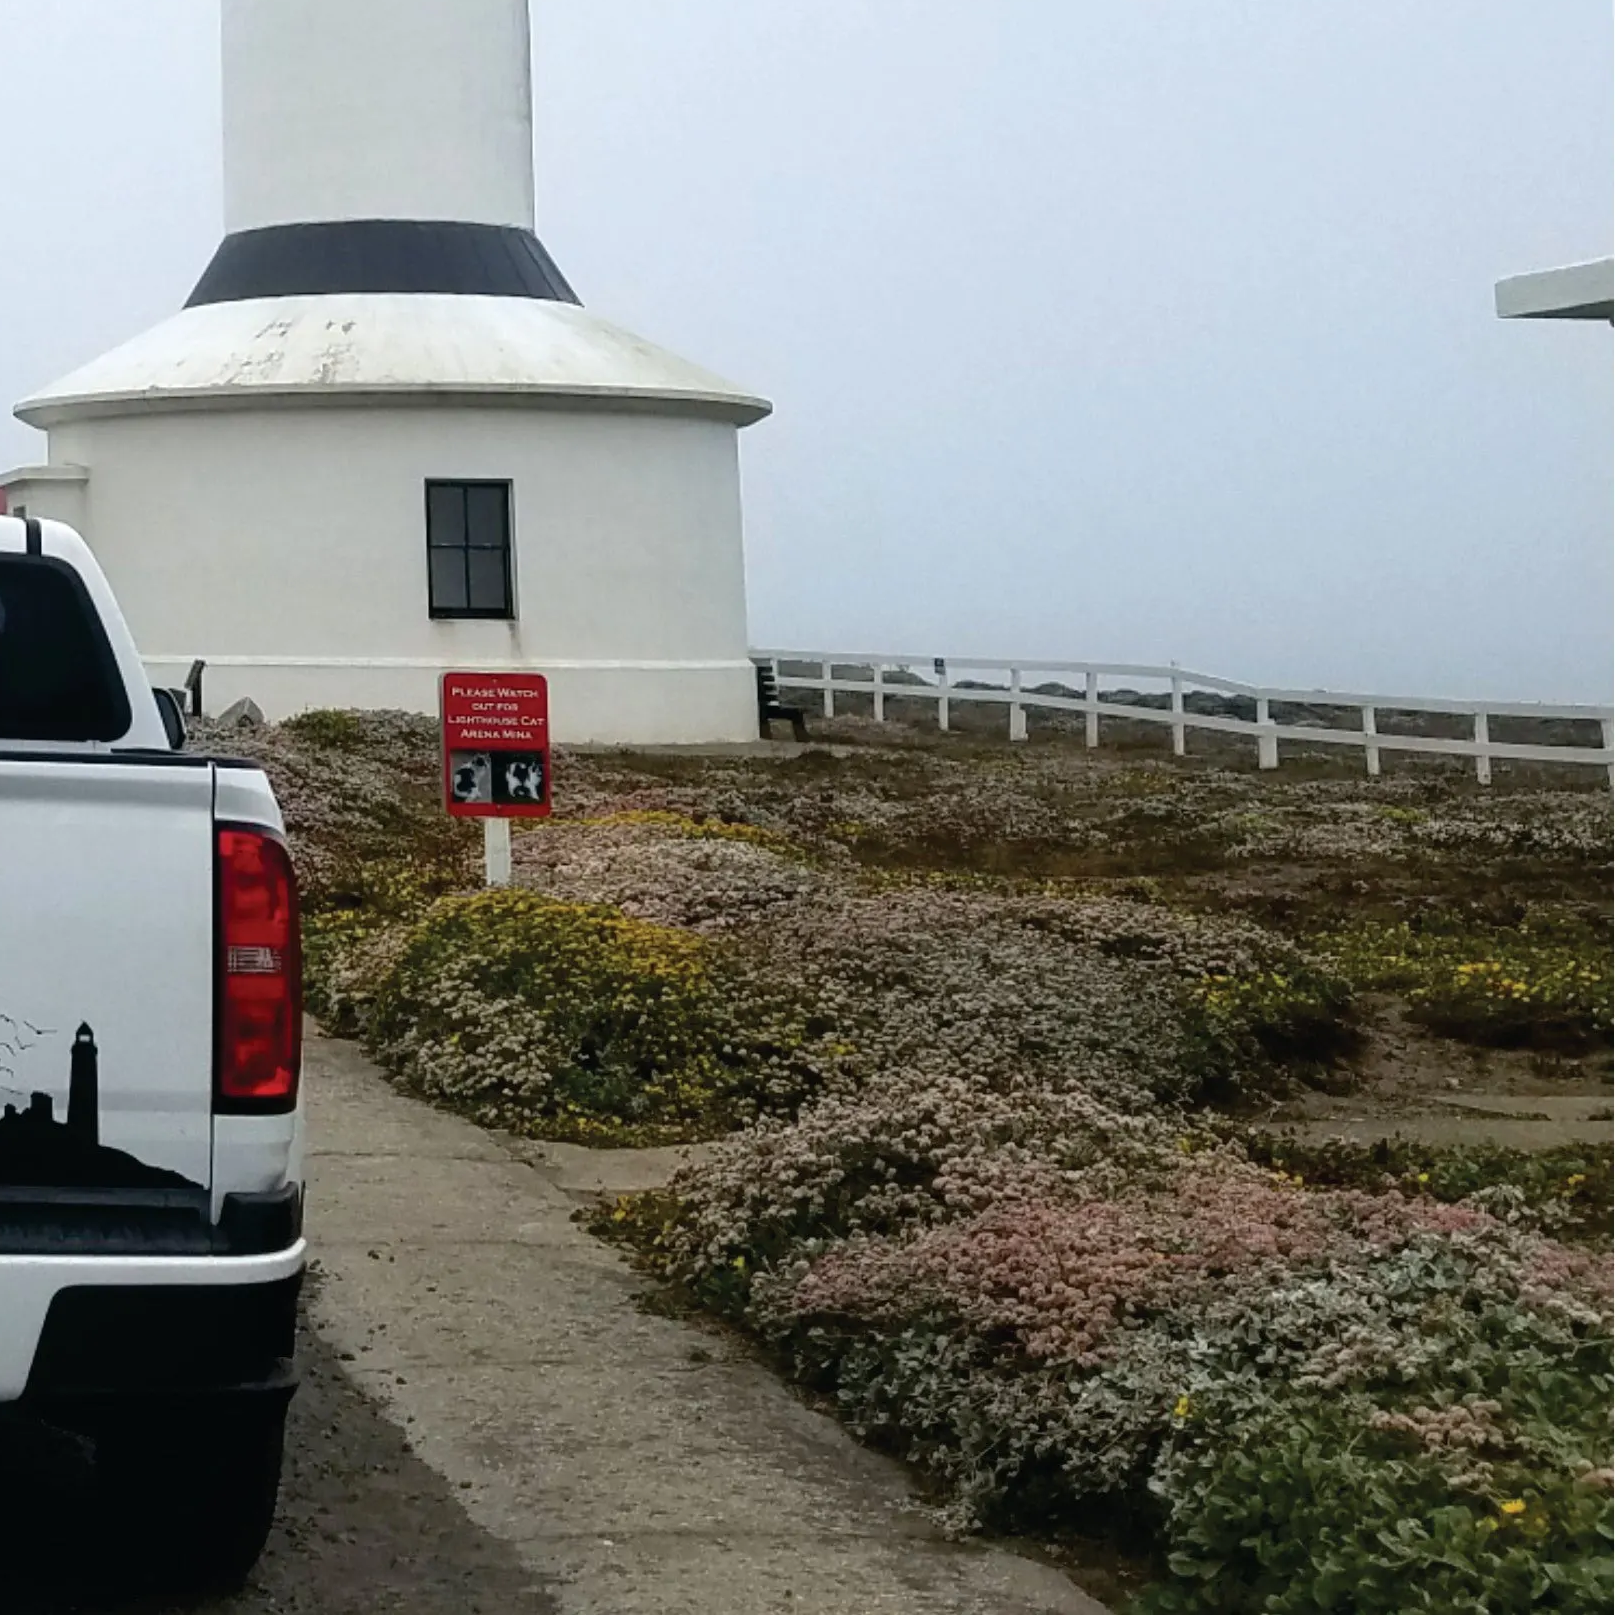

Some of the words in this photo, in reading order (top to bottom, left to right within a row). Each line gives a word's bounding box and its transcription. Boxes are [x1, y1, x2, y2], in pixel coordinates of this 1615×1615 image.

[451, 687, 496, 698] PLEASE
[497, 688, 540, 699] WATCH
[470, 702, 494, 711] OUT
[496, 702, 519, 711] FOR
[447, 715, 518, 725] LIGHTHOUSE
[521, 716, 545, 726] CAT
[460, 728, 500, 739] ARENA
